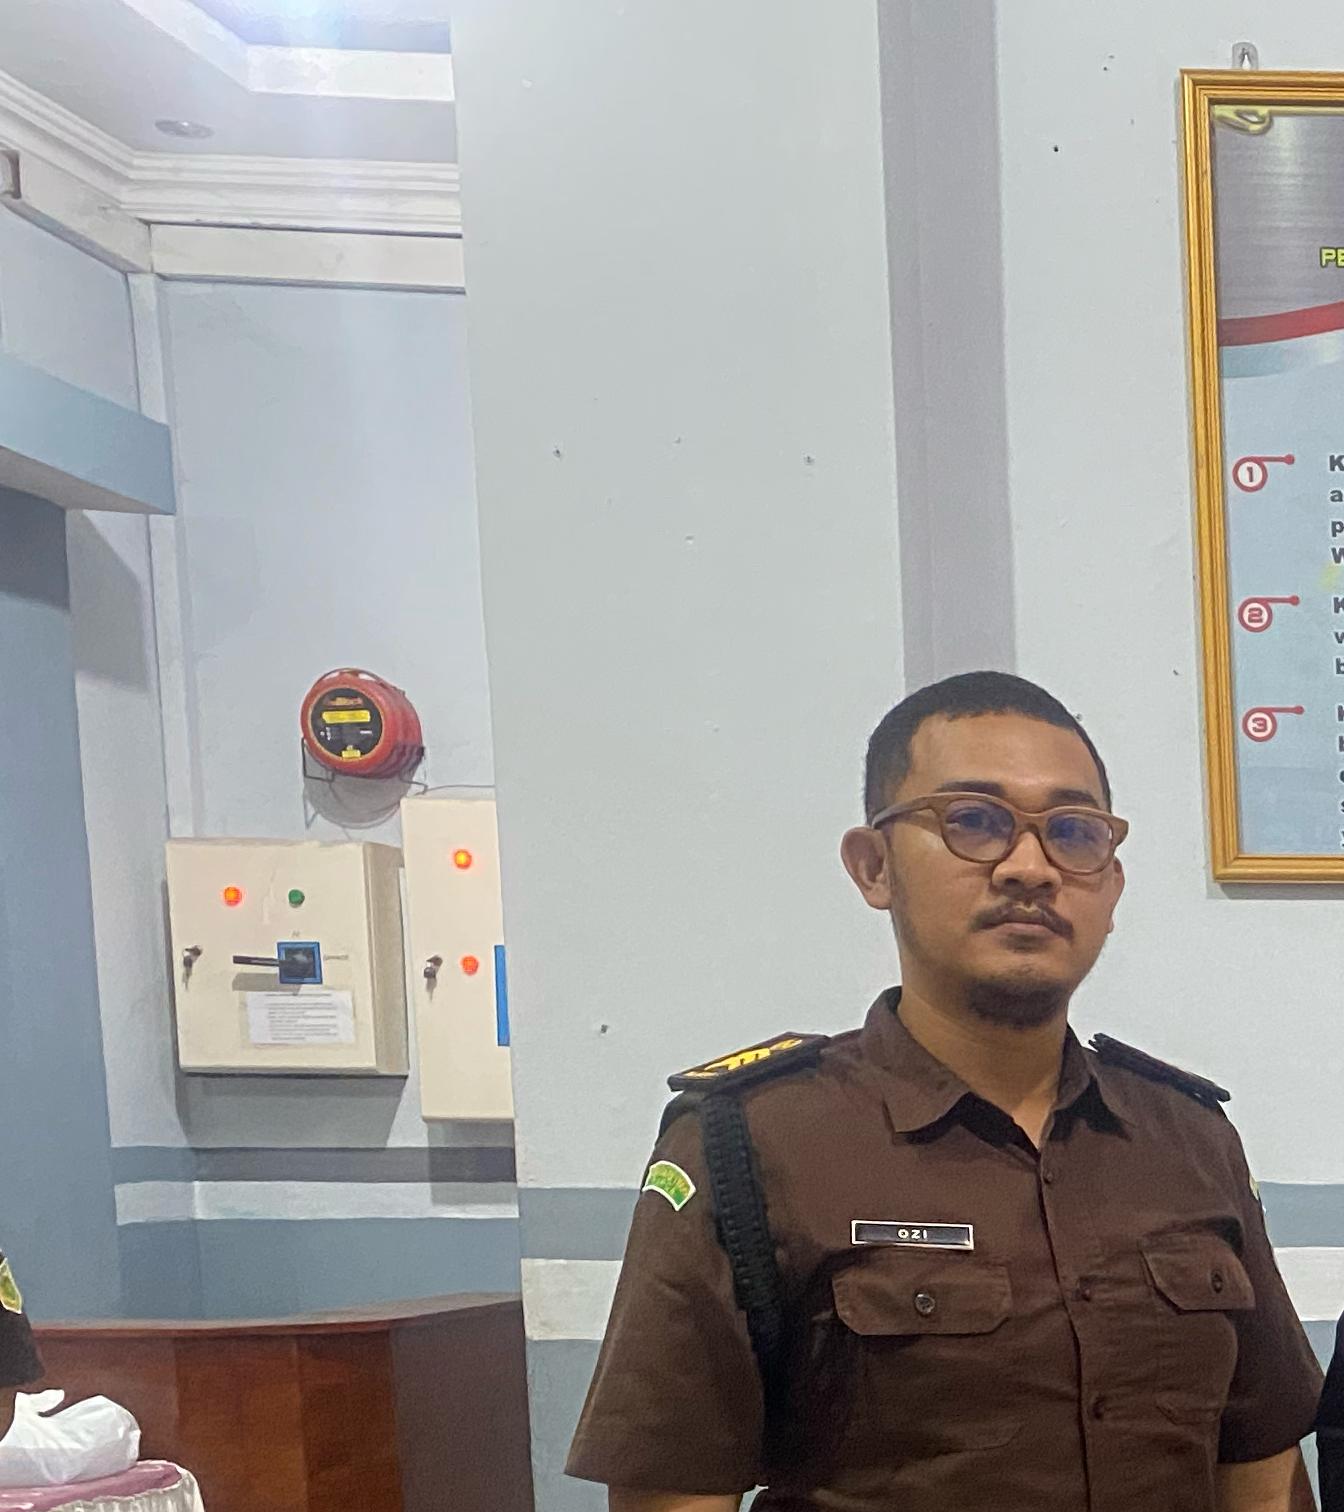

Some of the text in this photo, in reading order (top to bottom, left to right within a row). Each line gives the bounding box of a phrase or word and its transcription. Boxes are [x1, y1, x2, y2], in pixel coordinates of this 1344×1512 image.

[1246, 466, 1254, 483] 1
[1248, 607, 1263, 623] 2
[1252, 717, 1268, 733] 3
[898, 1229, 928, 1239] OZI
